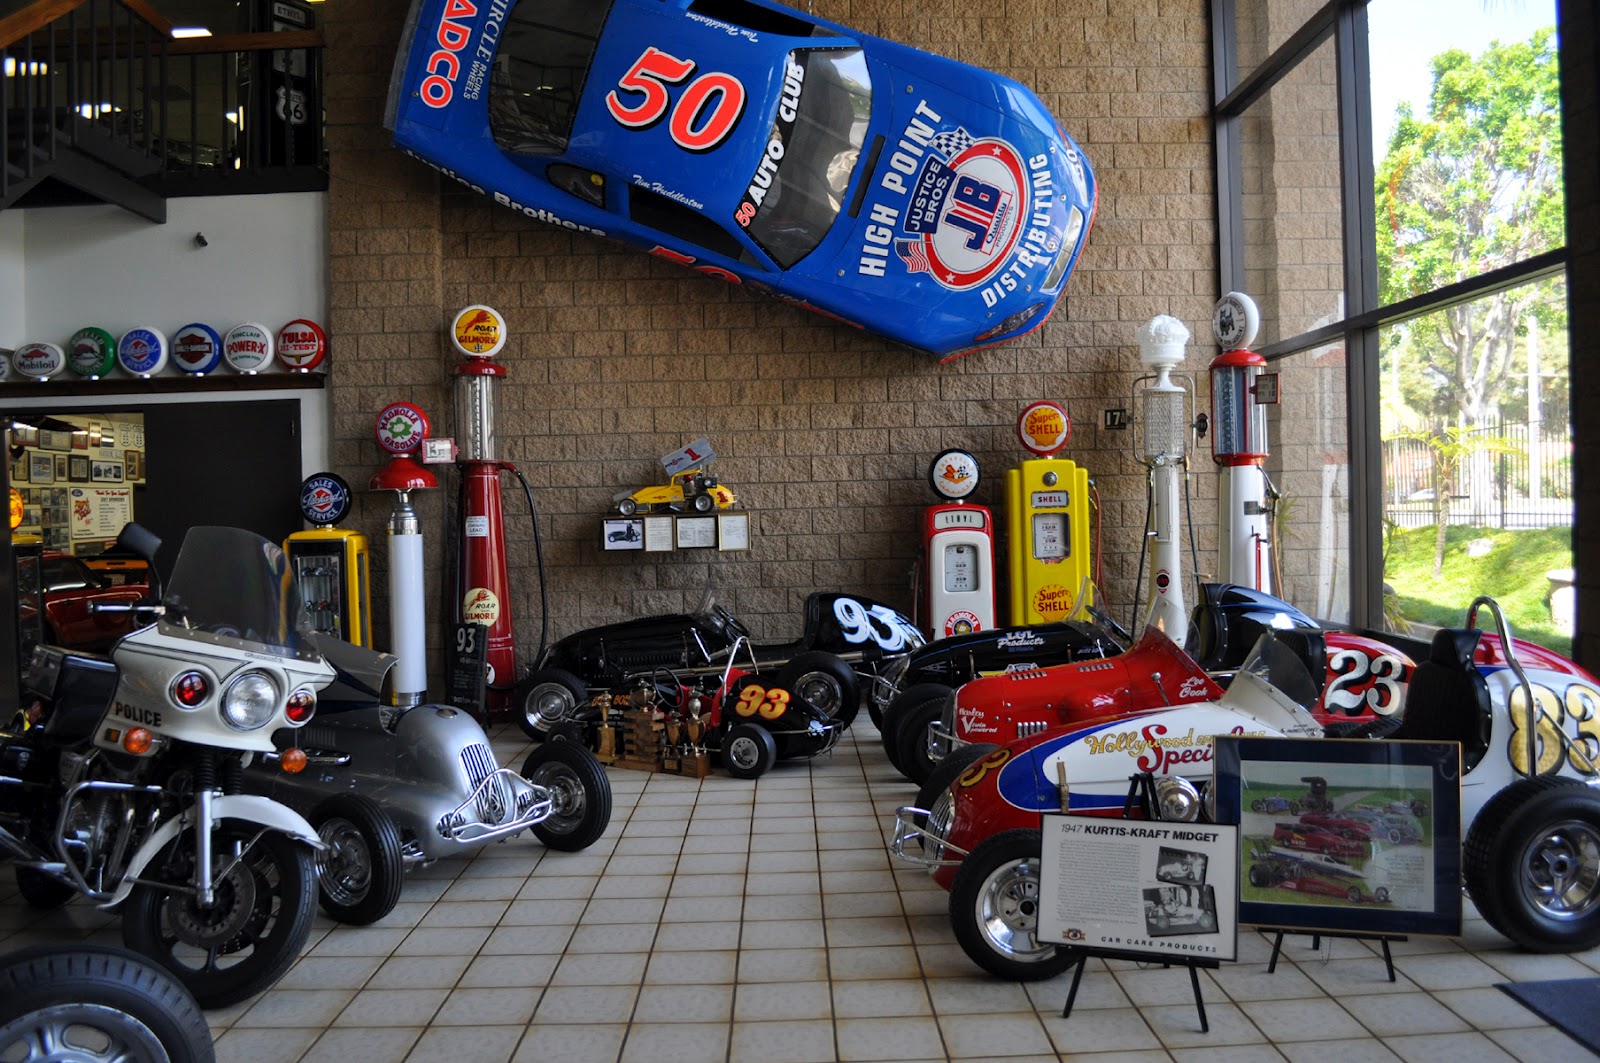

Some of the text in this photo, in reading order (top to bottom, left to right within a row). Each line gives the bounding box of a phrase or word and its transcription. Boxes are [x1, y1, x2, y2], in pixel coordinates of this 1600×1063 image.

[685, 11, 759, 43] Tim Huddleston
[463, 60, 480, 99] WHEELS
[471, 63, 487, 100] RACING
[283, 91, 302, 100] RUTE
[605, 46, 746, 151] 50
[735, 62, 805, 227] 50 AUTO CLUB
[632, 174, 704, 210] Tim Huddleston
[859, 99, 942, 277] HIGH POINT
[911, 161, 942, 231] JUSTICE
[924, 176, 950, 223] BROS.
[494, 191, 607, 237] Brothers
[986, 202, 1007, 244] Quality
[981, 153, 1053, 309] DISTRIBUTING
[995, 206, 1014, 248] PRODUCTS
[282, 331, 316, 343] TULSA
[458, 336, 496, 344] GILMORE
[19, 360, 55, 369] Mobiloil
[380, 408, 419, 431] MAGNOLIA
[1028, 423, 1061, 436] SHELL
[1029, 409, 1060, 426] Super
[384, 430, 421, 449] GASOLINE
[684, 448, 701, 461] 1
[309, 480, 333, 489] SALES
[716, 491, 728, 503] 1
[308, 507, 338, 520] SERVICE
[1038, 601, 1069, 612] SHELL
[1039, 589, 1068, 602] Super
[464, 612, 495, 620] GILMORE
[833, 597, 906, 652] 93
[946, 611, 979, 628] MAGNOLIA
[457, 627, 476, 653] 93
[997, 637, 1046, 649] Products
[1179, 687, 1208, 698] Cook
[1180, 676, 1205, 688] Lee
[1324, 649, 1405, 716] 23
[735, 684, 791, 721] 93
[115, 702, 162, 728] POLICE
[1507, 681, 1600, 777] 83
[1084, 727, 1195, 758] Hollywood
[1137, 724, 1214, 775] Speci
[1061, 823, 1219, 843] 1947 KURTIS-KRAFT MIDGET
[1101, 936, 1217, 953] CAR CARE PRODUCTS
